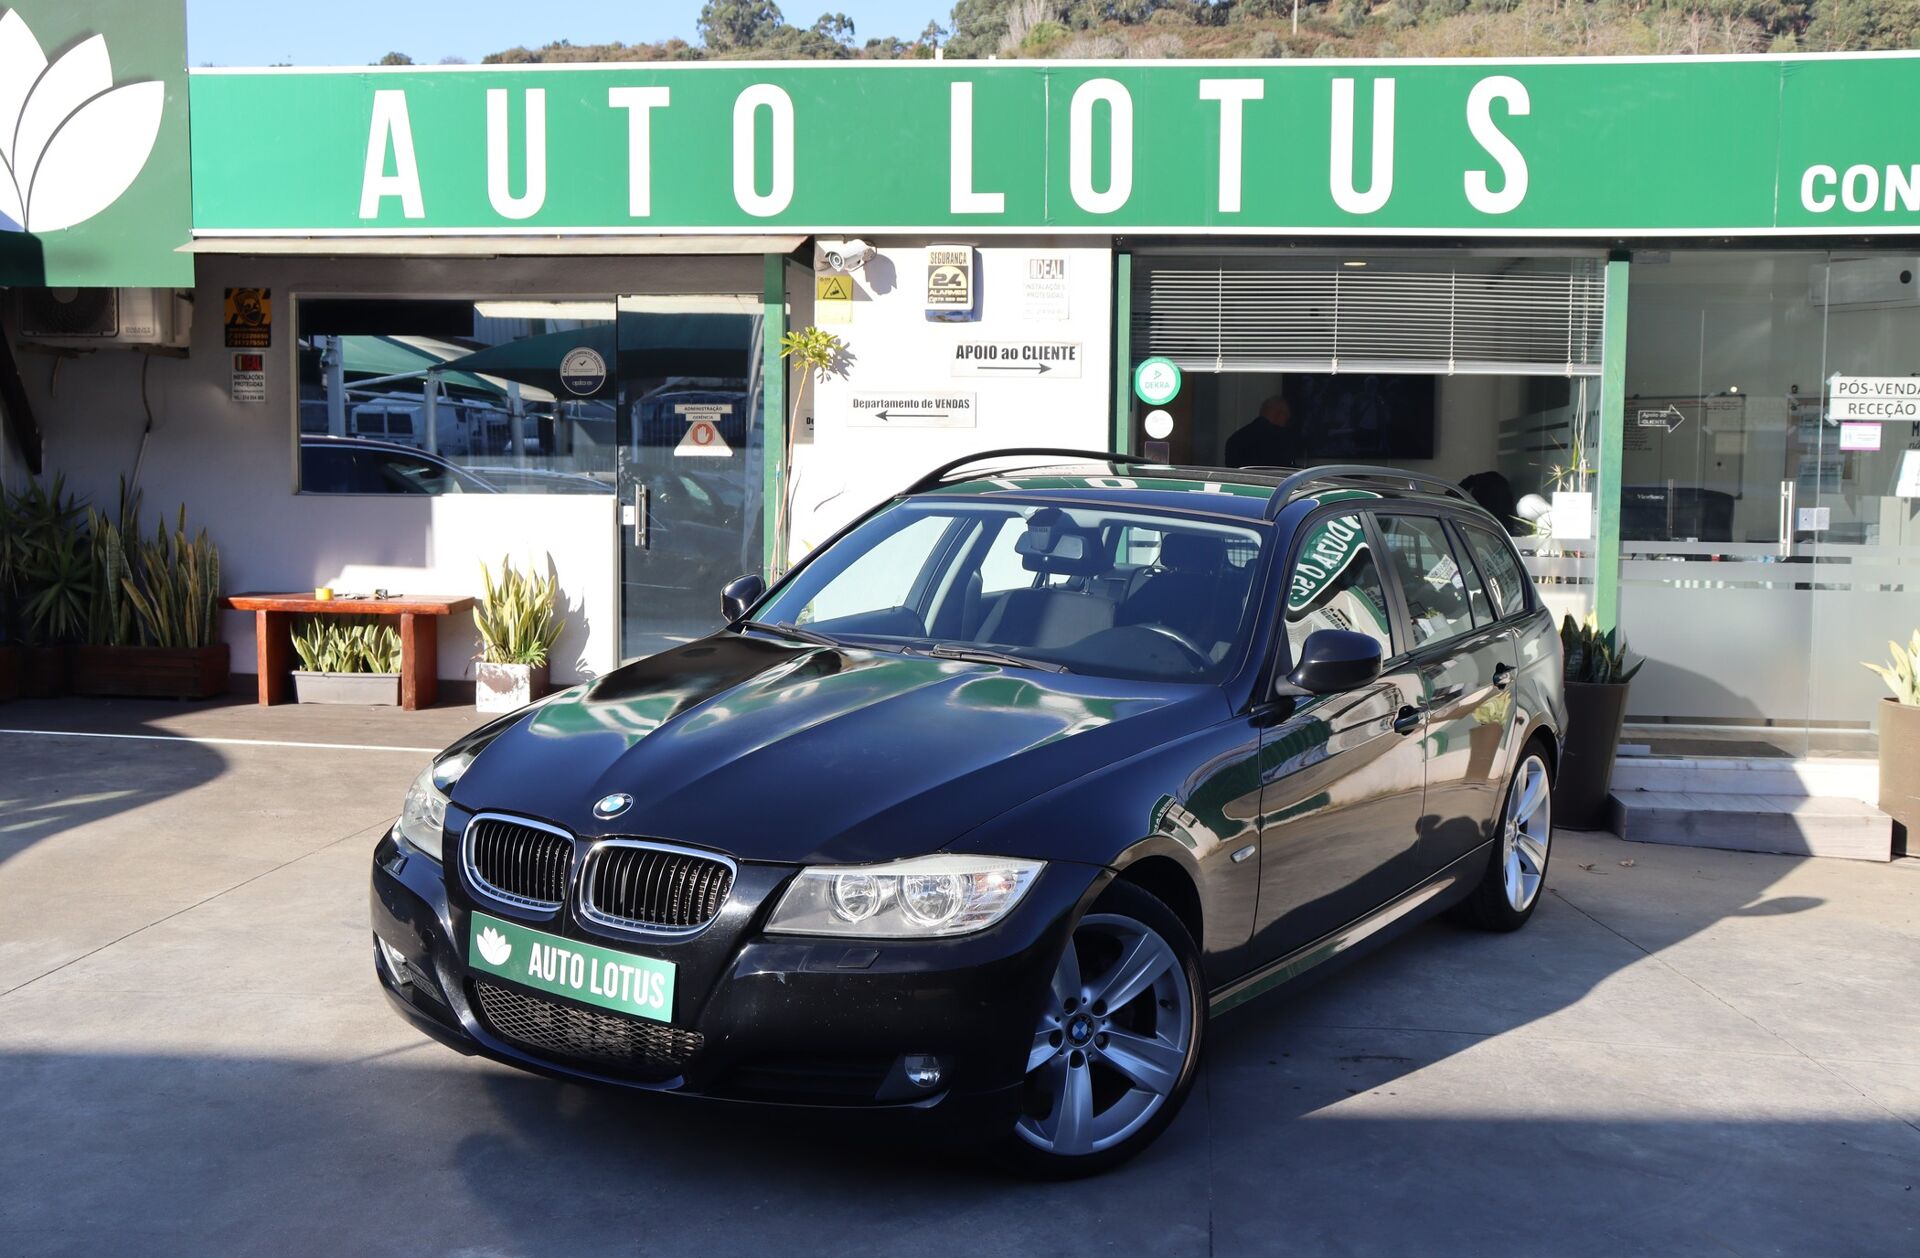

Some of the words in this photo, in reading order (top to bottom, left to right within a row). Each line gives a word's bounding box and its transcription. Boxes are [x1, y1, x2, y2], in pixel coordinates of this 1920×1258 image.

[358, 83, 795, 220] AUTO
[950, 75, 1531, 214] LOTUS
[932, 273, 962, 287] 24
[955, 345, 997, 360] APOIO
[1001, 348, 1018, 360] ao
[1022, 345, 1076, 360] CLIENTE
[1144, 381, 1170, 389] DEKRA
[852, 398, 919, 410] Departamento
[921, 398, 933, 409] de
[935, 399, 970, 409] VENDAS
[1848, 401, 1917, 418] RECEÇÃO
[528, 942, 585, 989] AUTO
[590, 958, 665, 1009] LOTUS
